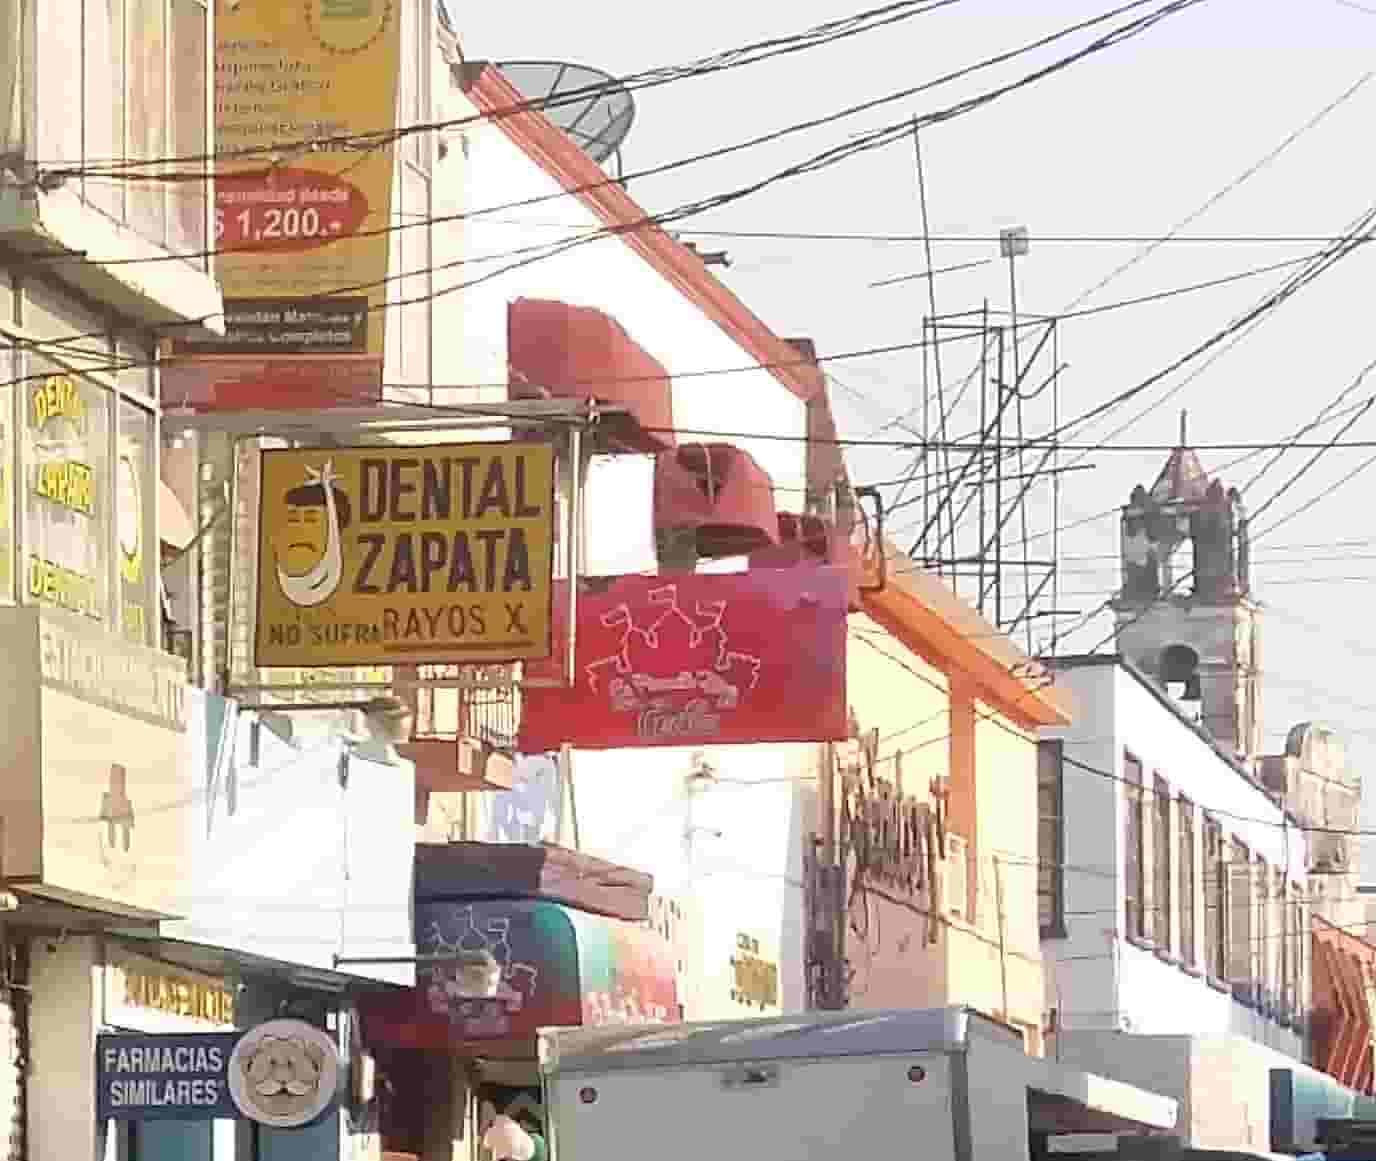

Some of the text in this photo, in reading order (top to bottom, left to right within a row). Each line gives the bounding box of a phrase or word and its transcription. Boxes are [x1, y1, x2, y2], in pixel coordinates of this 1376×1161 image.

[359, 455, 543, 523] DENTAL
[355, 527, 533, 594] ZAPATA
[269, 623, 302, 647] NO
[384, 602, 528, 639] RAYOS X
[104, 1046, 224, 1074] FARMACIAS
[109, 1078, 220, 1106] SIMILARES
